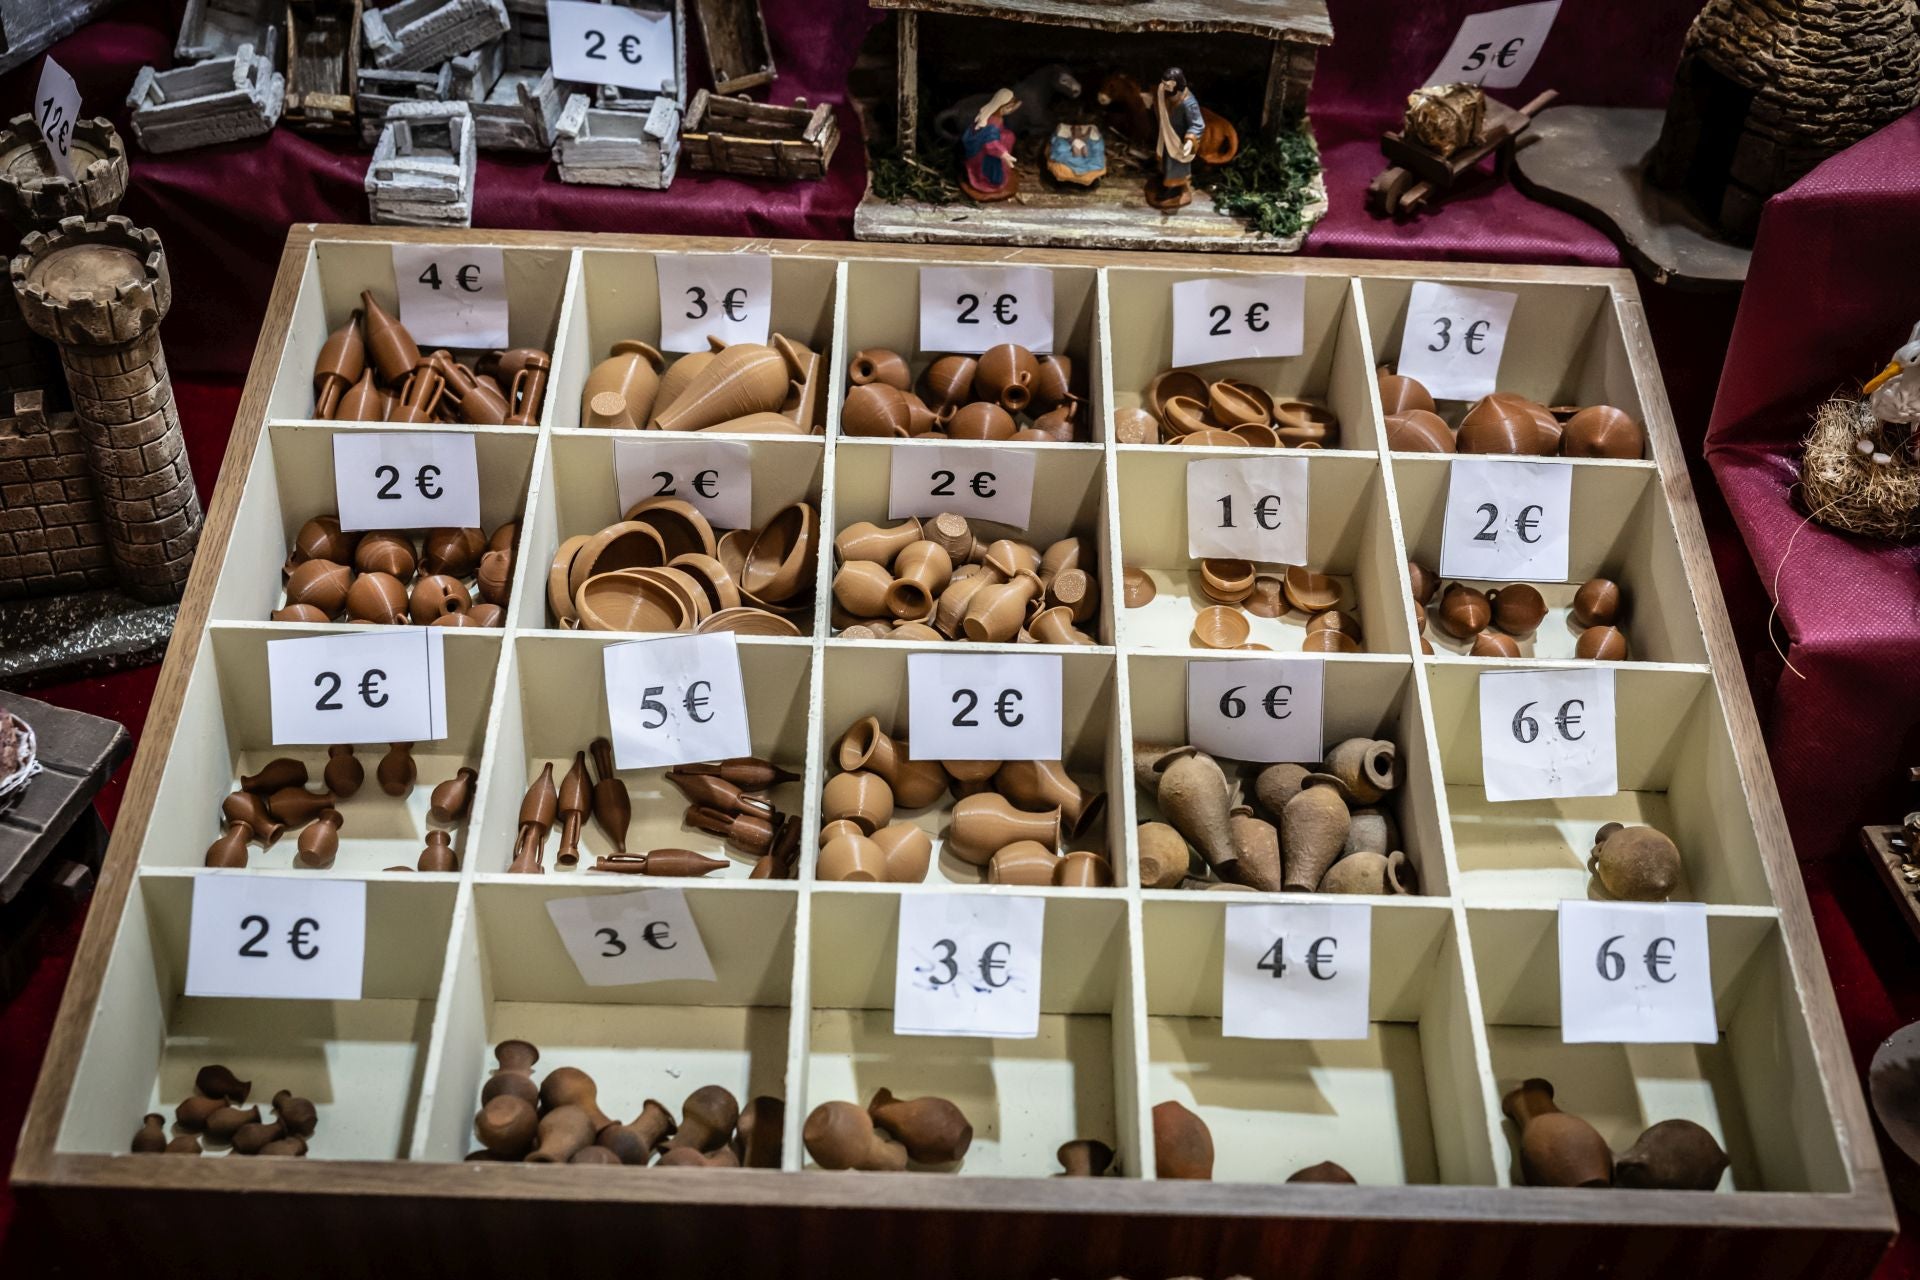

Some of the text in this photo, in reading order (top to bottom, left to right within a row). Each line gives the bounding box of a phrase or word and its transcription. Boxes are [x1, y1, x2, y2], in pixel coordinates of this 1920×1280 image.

[584, 29, 643, 65] 2 €
[1461, 37, 1525, 72] 5 €
[418, 262, 483, 293] 4 €
[685, 286, 748, 322] 3 €
[956, 293, 1018, 326] 2 €
[1209, 302, 1270, 337] 2 €
[1427, 317, 1491, 355] 3 €
[374, 464, 444, 500] 2 €
[651, 469, 720, 499] 2 €
[930, 470, 997, 499] 2 €
[1216, 494, 1281, 531] 1 €
[1473, 502, 1544, 544] 2 €
[314, 668, 389, 711] 2 €
[640, 680, 715, 730] 5 €
[951, 688, 1024, 728] 2 €
[1219, 685, 1293, 720] 6 €
[1511, 699, 1586, 744] 6 €
[238, 914, 320, 961] 2 €
[594, 921, 677, 958] 3 €
[928, 938, 1012, 988] 3 €
[1256, 936, 1337, 981] 4 €
[1596, 935, 1677, 984] 6 €
